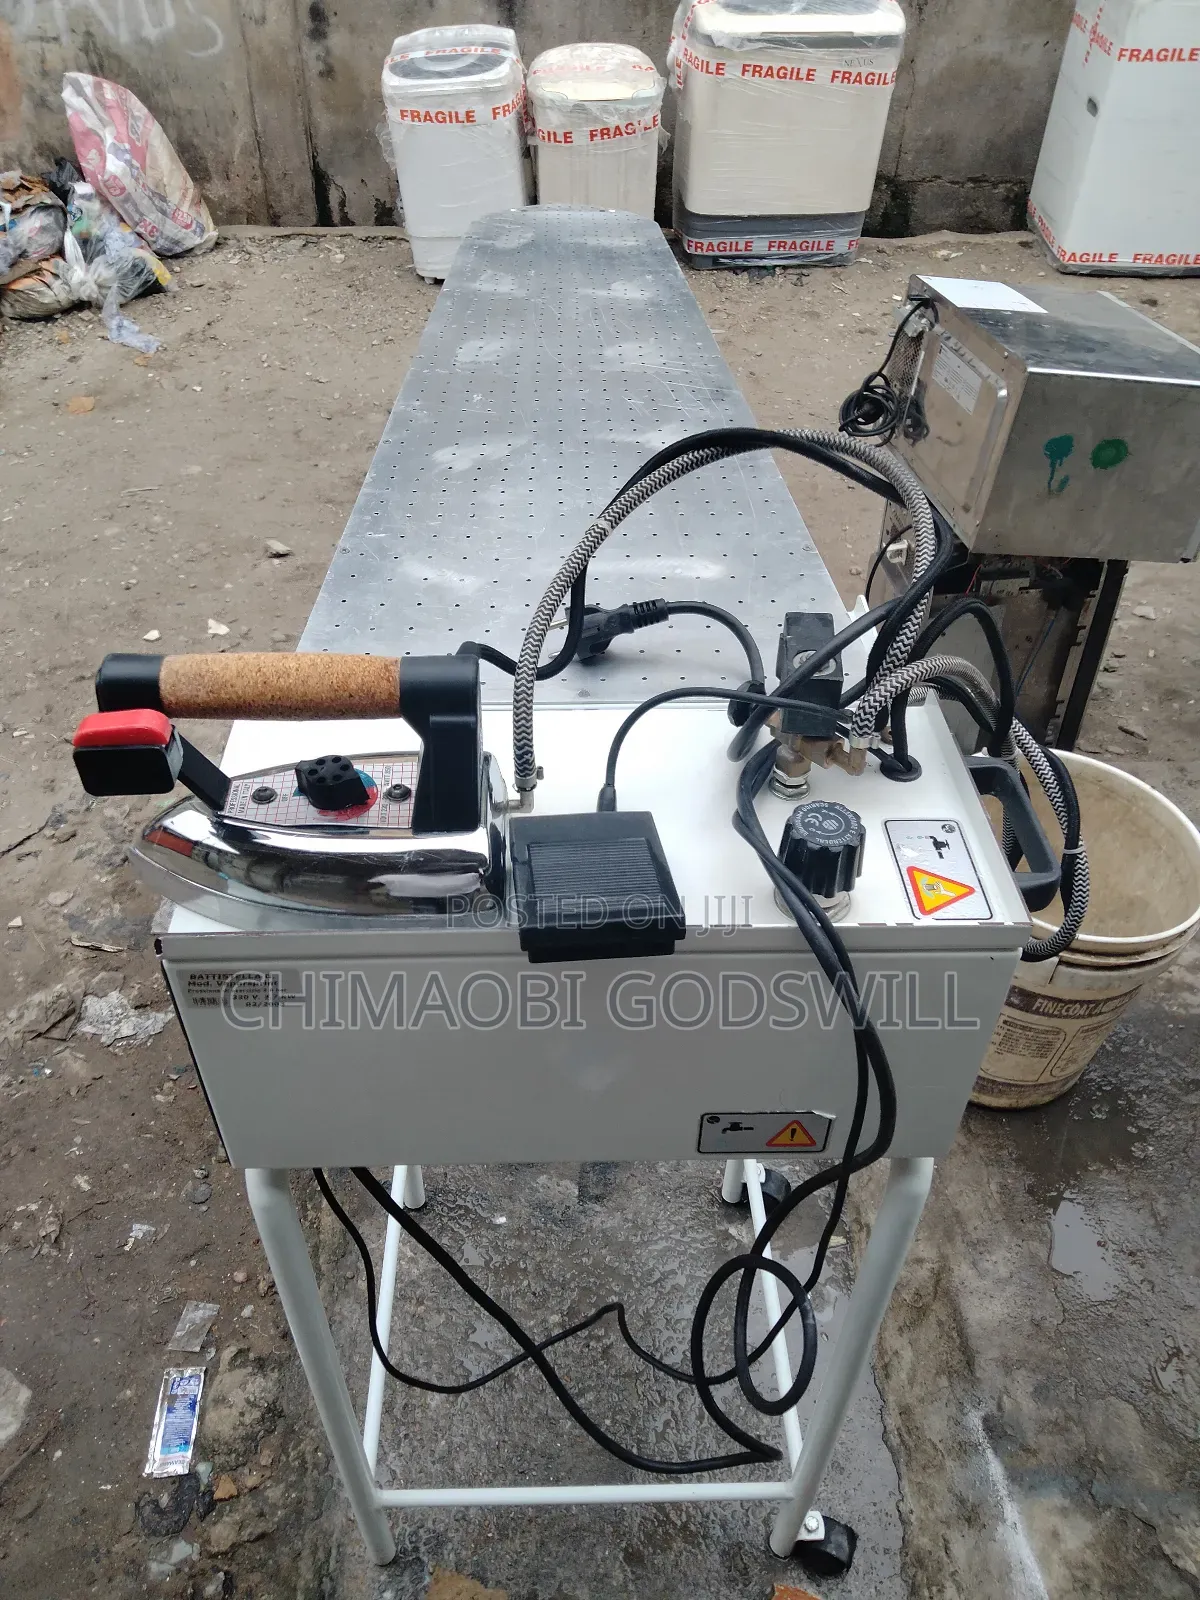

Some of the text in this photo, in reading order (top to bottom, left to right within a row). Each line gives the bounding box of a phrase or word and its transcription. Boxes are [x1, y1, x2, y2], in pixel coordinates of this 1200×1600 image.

[424, 47, 501, 56] FRAGILE
[1117, 47, 1200, 63] FRAGILE
[683, 47, 726, 76] RAGILE
[741, 63, 817, 82] FRAGILE
[830, 69, 896, 86] FRAGILE
[399, 109, 477, 124] FRAGILE
[537, 113, 659, 145] GILE FRAGLE
[687, 239, 754, 253] FRAGILE
[767, 240, 836, 252] FRAGILE
[1057, 245, 1119, 263] FRAGILE
[1132, 253, 1200, 266] FRAGILE
[1032, 997, 1095, 1017] FINECOAT
